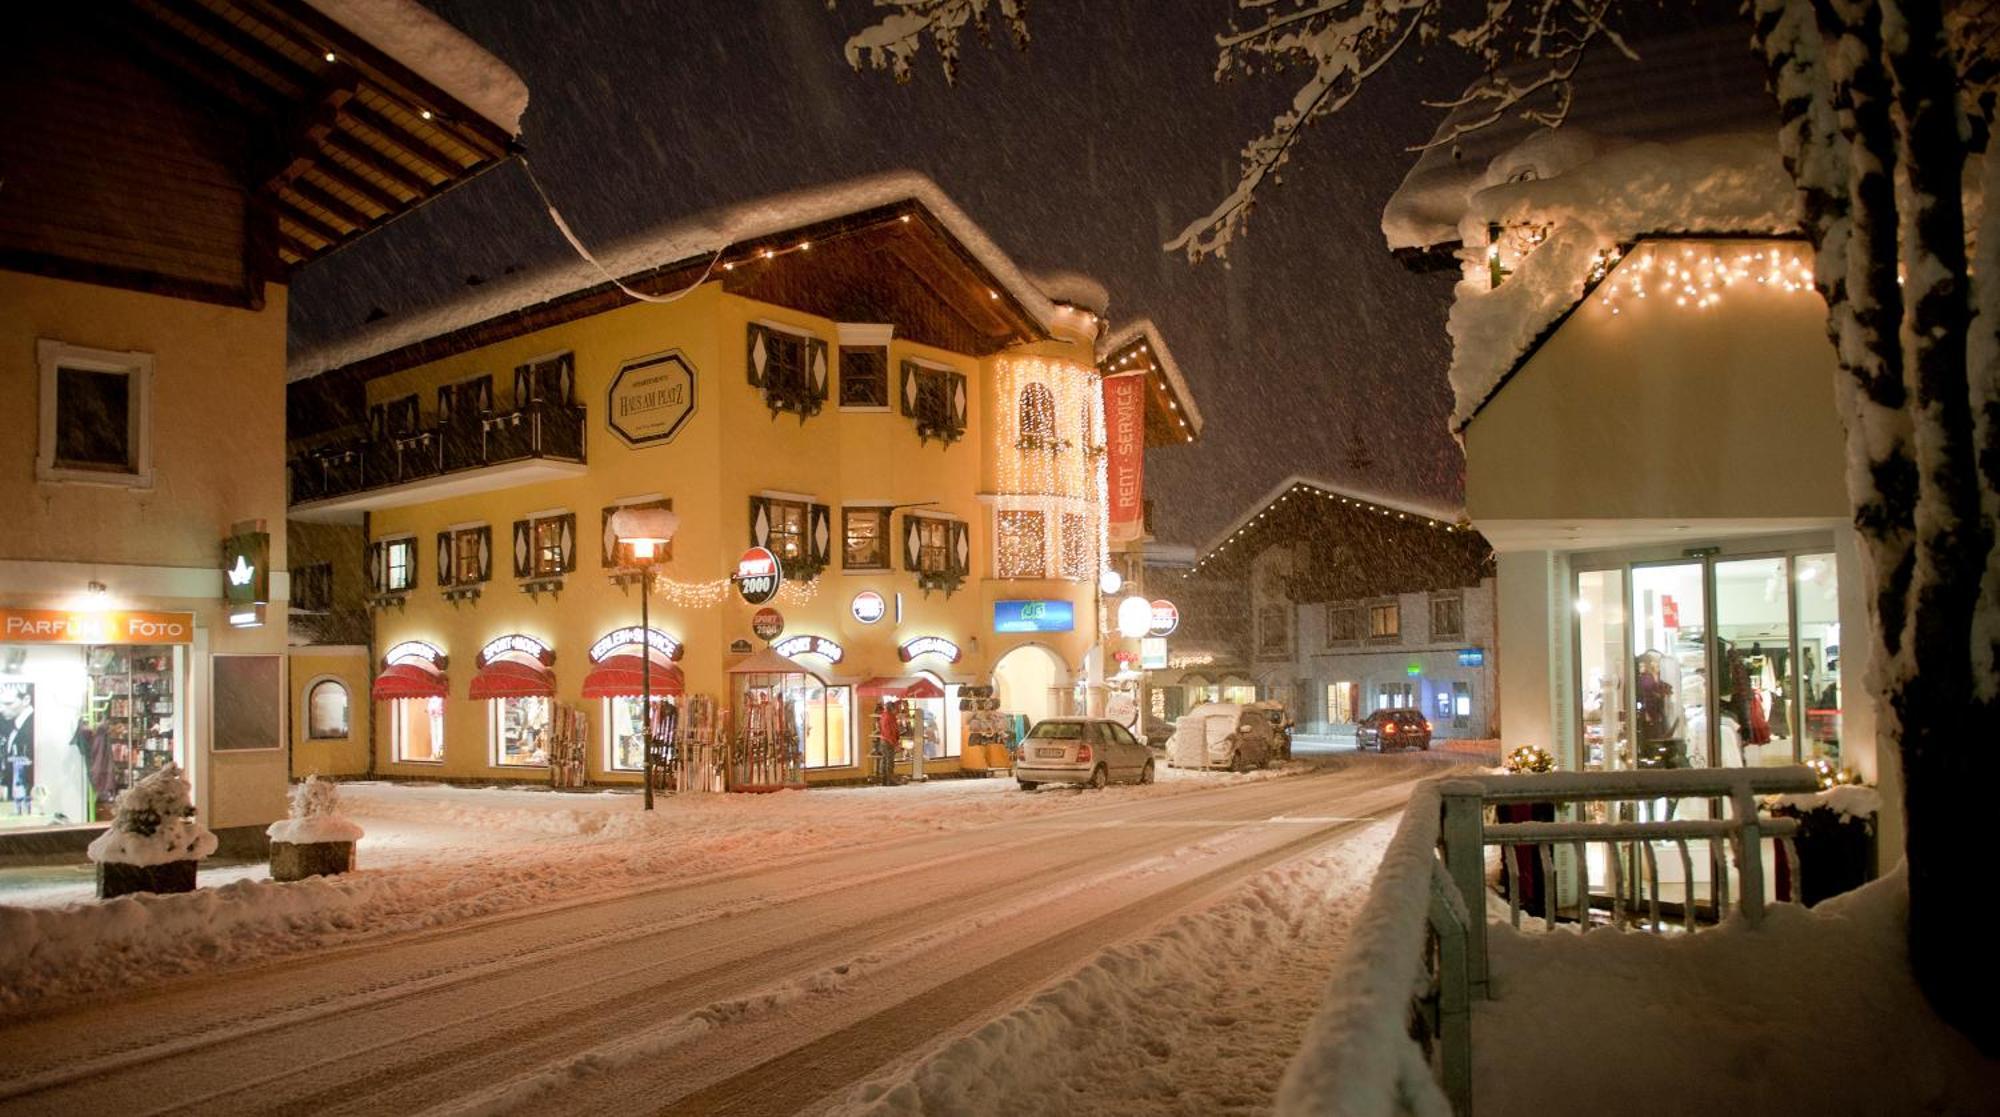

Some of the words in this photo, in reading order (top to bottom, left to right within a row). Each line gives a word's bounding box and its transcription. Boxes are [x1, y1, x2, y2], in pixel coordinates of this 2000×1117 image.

[643, 391, 656, 409] AM
[657, 383, 684, 406] PLATZ
[1116, 383, 1134, 457] SERVICE
[1119, 466, 1136, 508] RENT
[738, 558, 772, 577] SPORT
[742, 576, 770, 594] 2000
[128, 618, 183, 637] FOTO
[754, 614, 778, 624] SPORT
